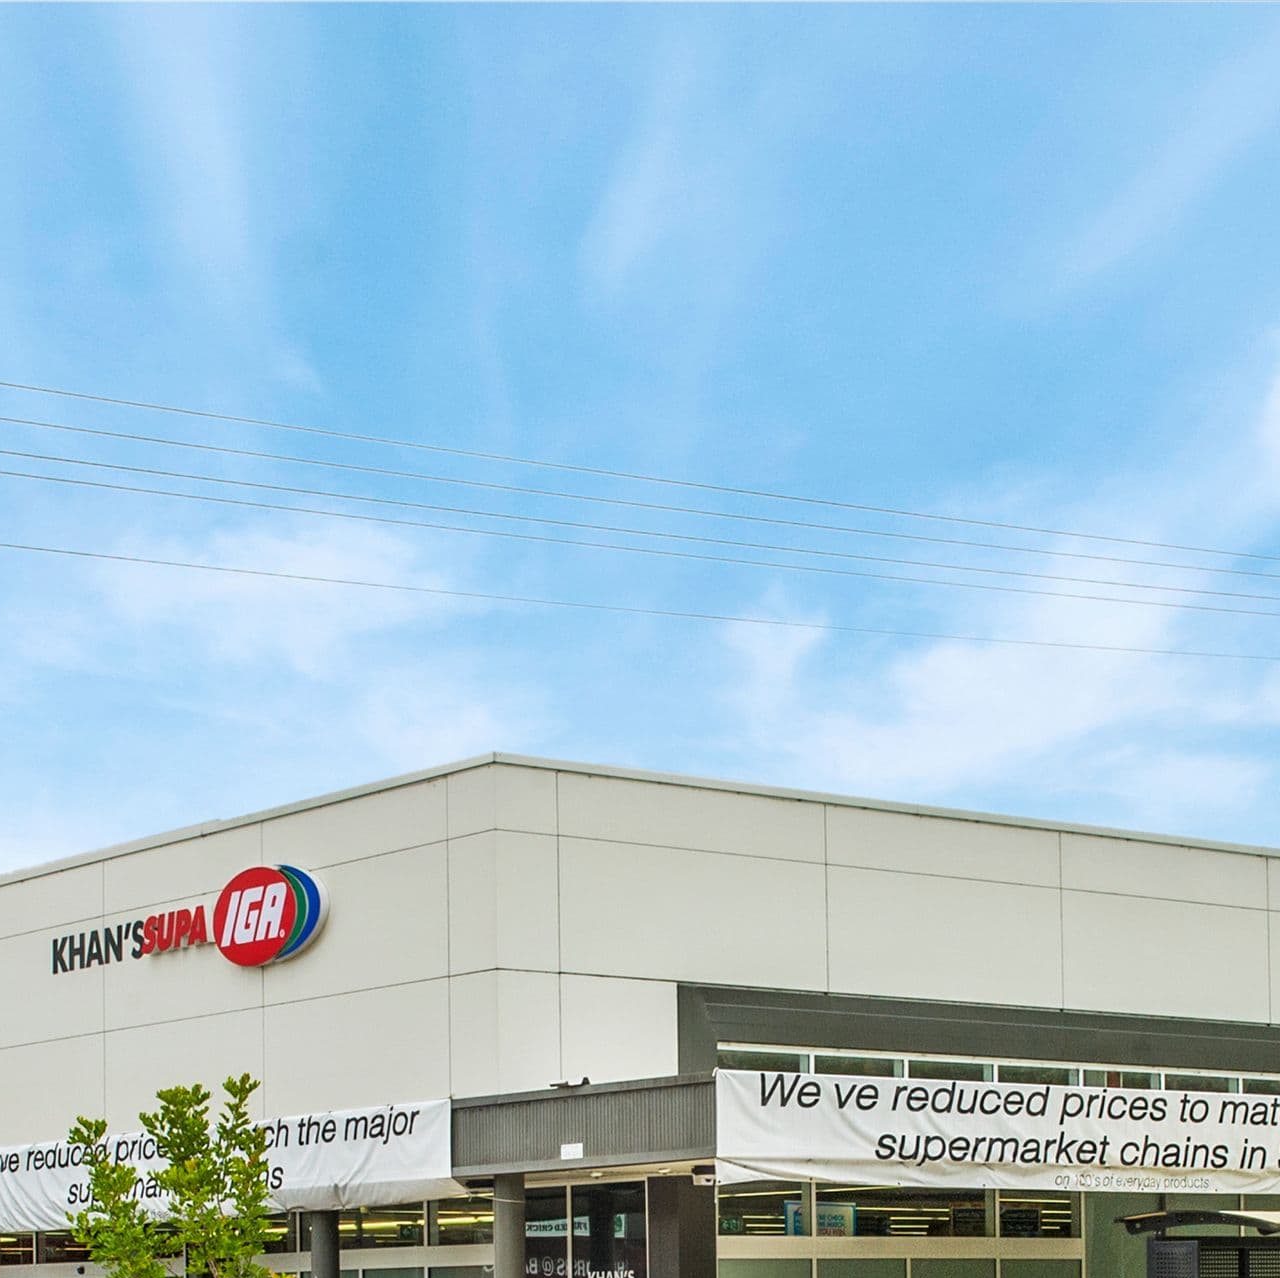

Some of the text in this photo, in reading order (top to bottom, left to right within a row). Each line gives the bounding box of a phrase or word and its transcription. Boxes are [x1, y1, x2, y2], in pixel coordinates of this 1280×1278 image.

[53, 882, 287, 974] KHAN'S SUPA IGA
[892, 1082, 1051, 1117] reduced
[1060, 1088, 1167, 1125] prices
[1179, 1094, 1209, 1124] to
[115, 1134, 169, 1167] price
[297, 1115, 336, 1147] the
[344, 1106, 420, 1145] major
[874, 1132, 1110, 1167] supermarket
[1120, 1135, 1228, 1170] chains
[1240, 1139, 1267, 1170] in
[1116, 1176, 1160, 1190] everyday
[1163, 1177, 1209, 1190] products
